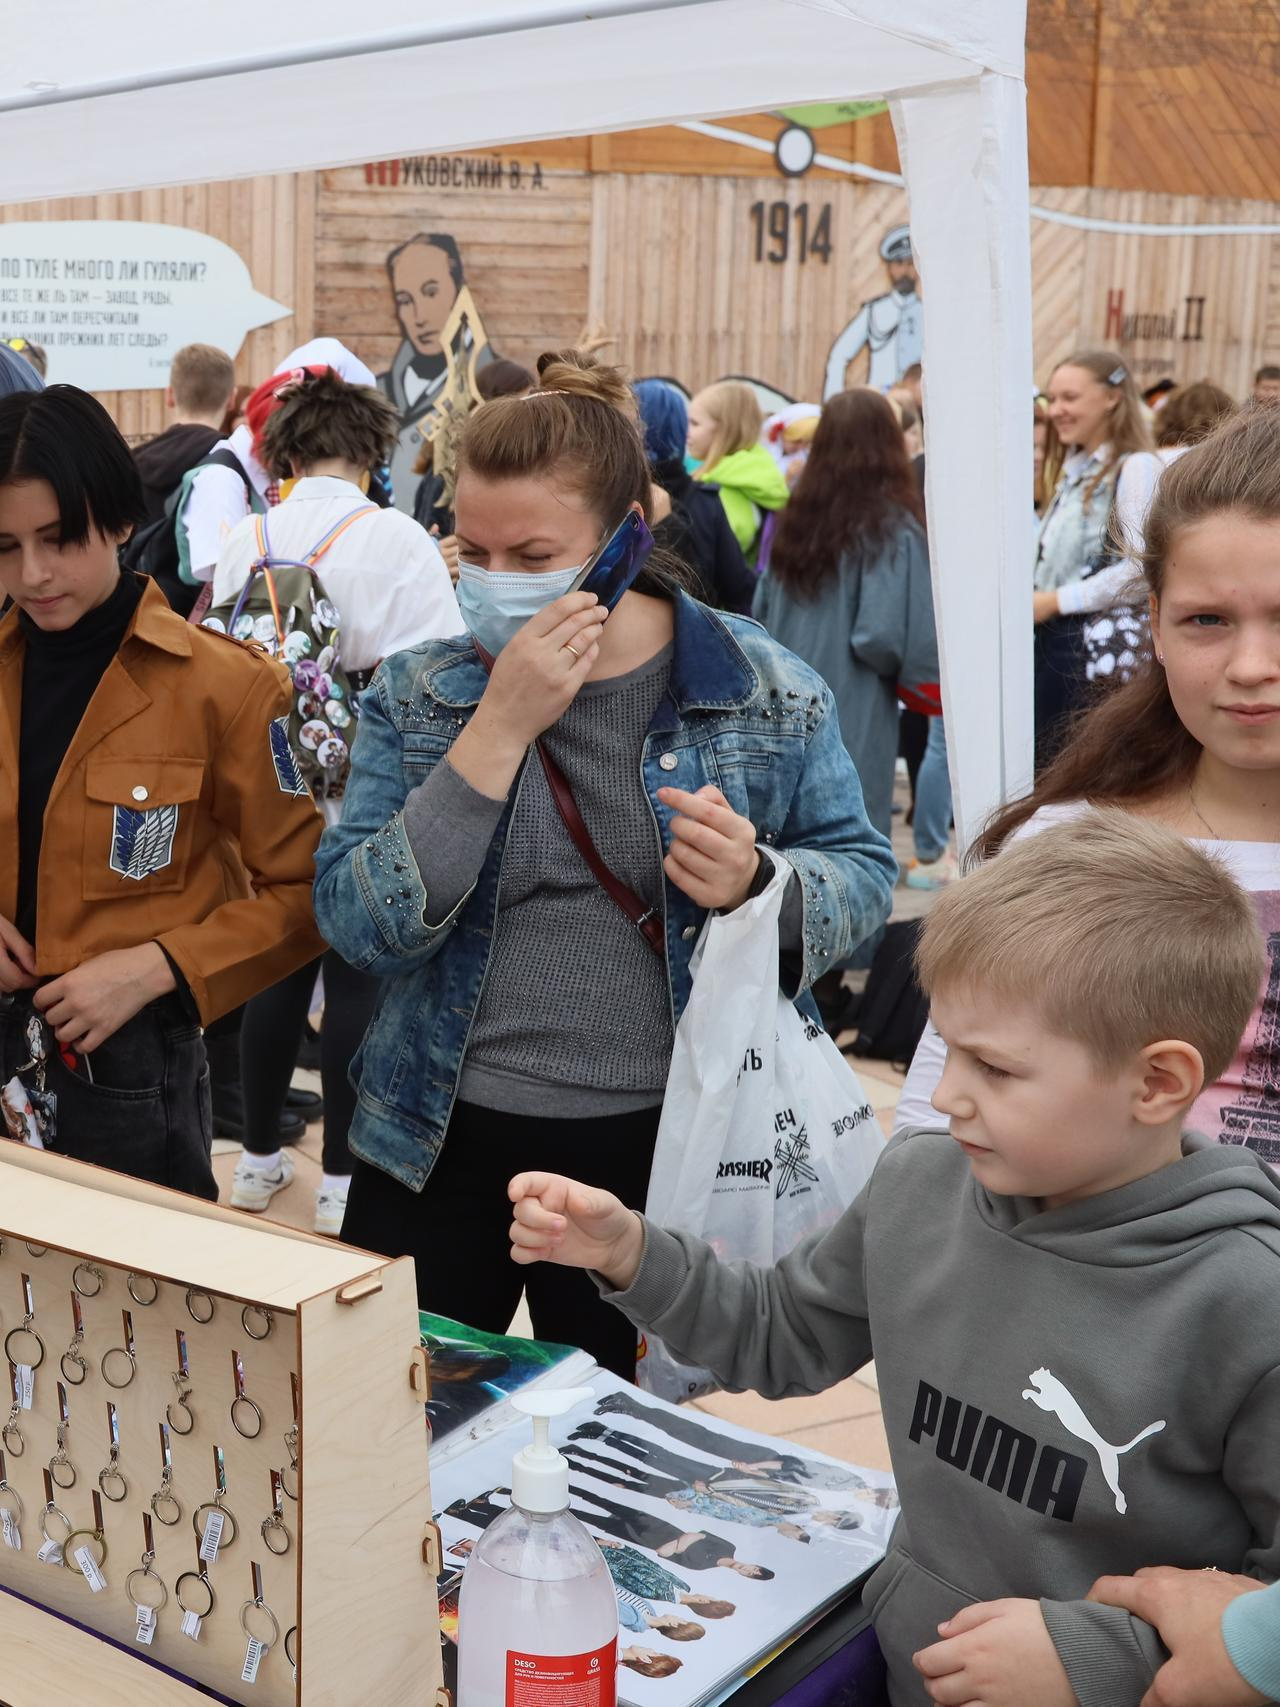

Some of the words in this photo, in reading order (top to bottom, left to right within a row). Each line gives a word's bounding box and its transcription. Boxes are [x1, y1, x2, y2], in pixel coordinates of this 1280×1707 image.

[751, 200, 832, 264] 1914
[0, 258, 20, 279] ПО
[24, 258, 58, 280] ТУЛЕ
[63, 259, 115, 280] МНОГО
[119, 260, 139, 281] ЛИ
[143, 260, 207, 282] ГУЛЯЛИ?
[716, 1158, 773, 1184] RASHER
[909, 1379, 1089, 1523] PUMA
[80, 1559, 91, 1573] 300
[514, 1659, 536, 1669] DESO
